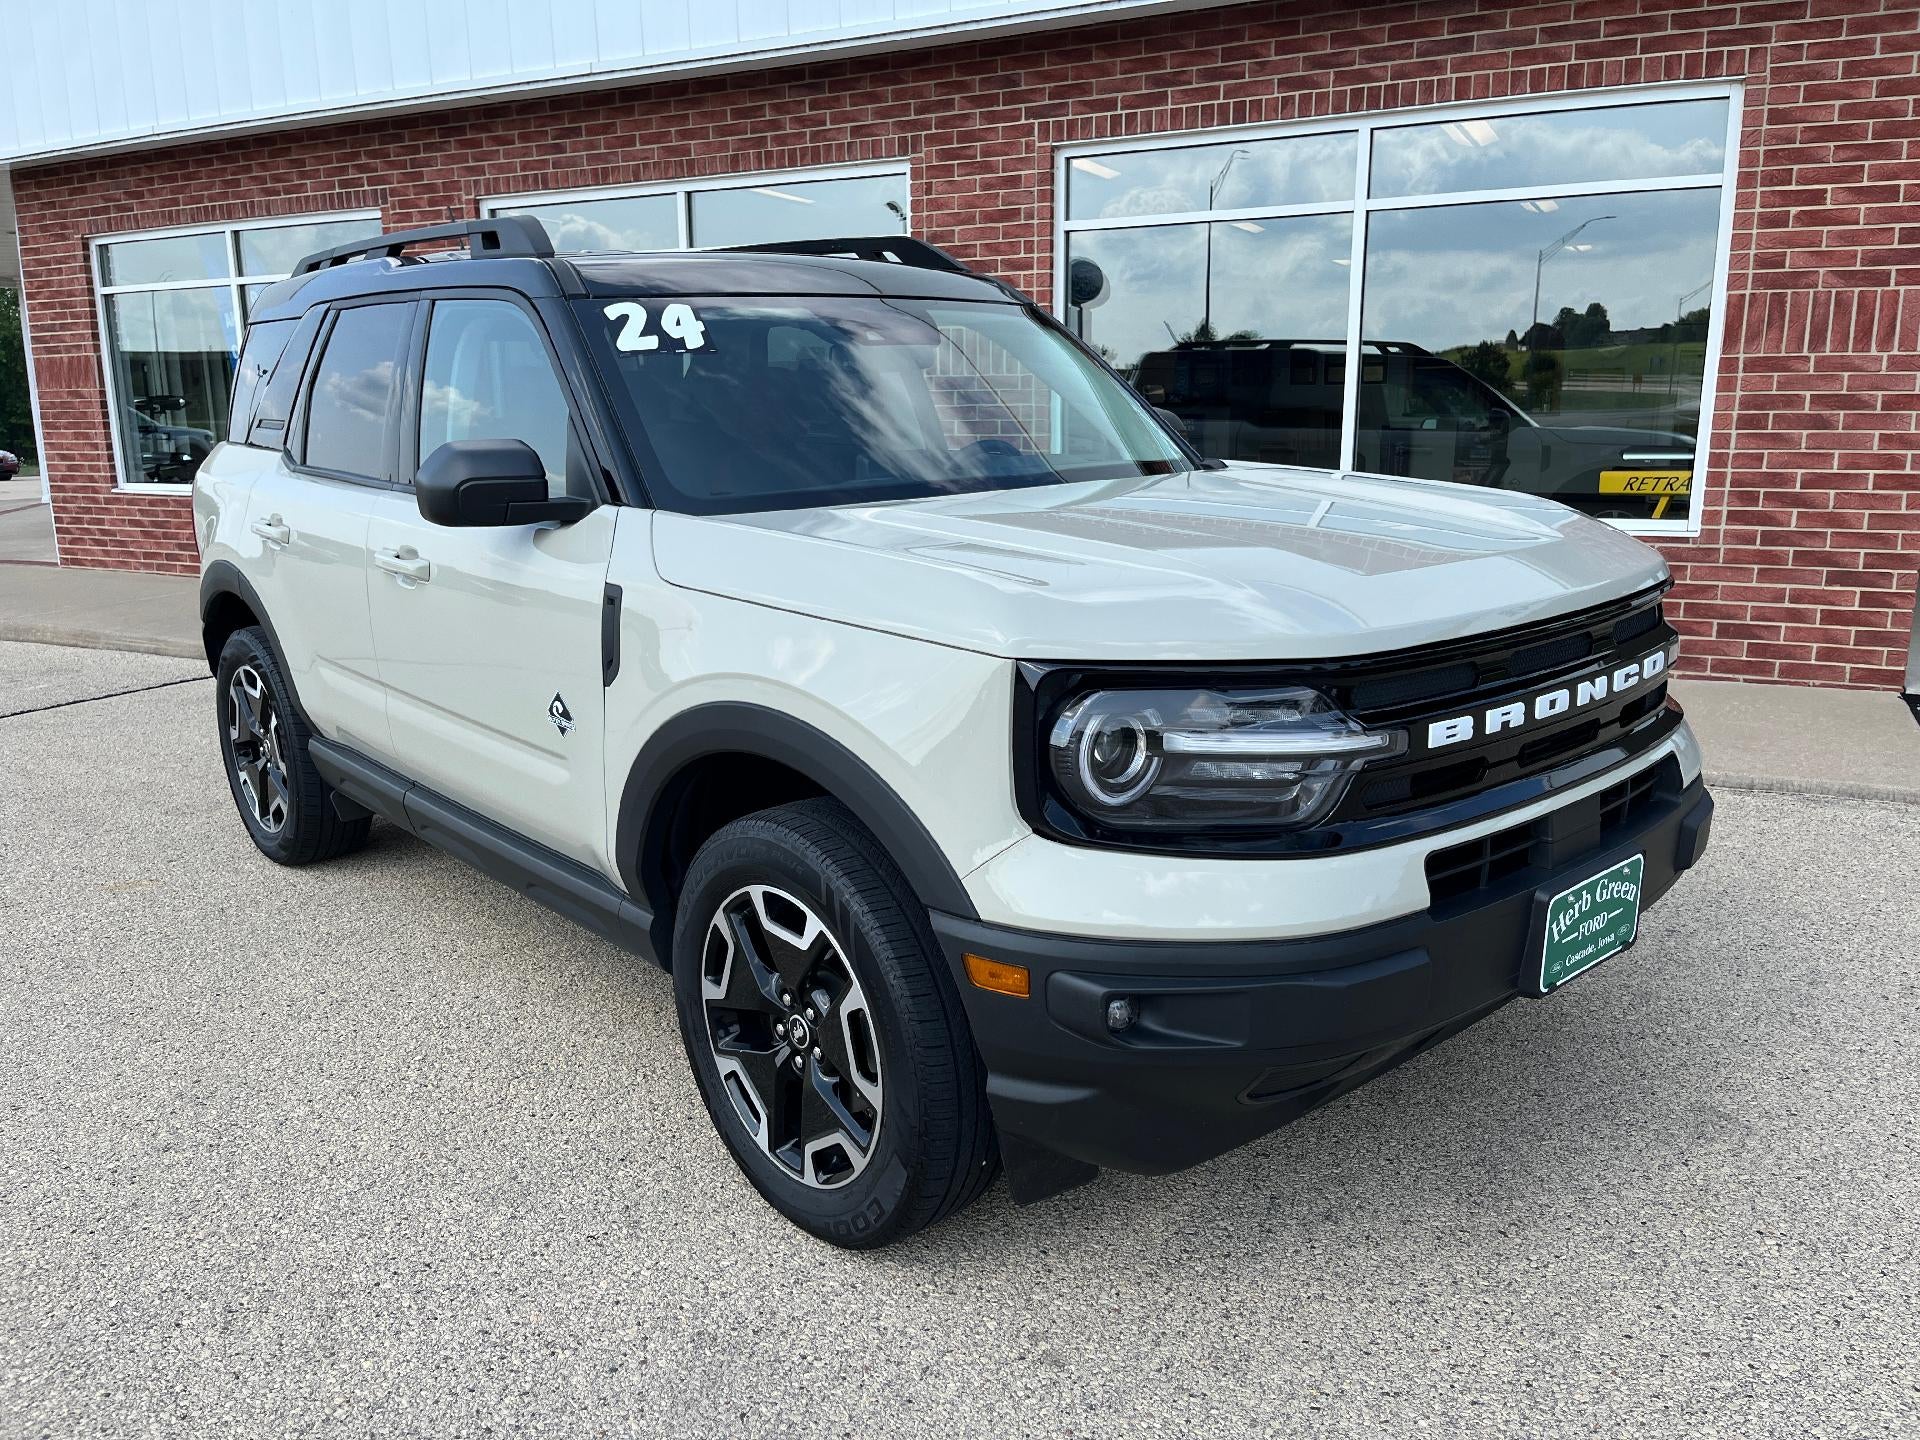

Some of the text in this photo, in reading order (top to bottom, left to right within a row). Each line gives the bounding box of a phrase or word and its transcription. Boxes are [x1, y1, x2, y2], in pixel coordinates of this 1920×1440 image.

[603, 302, 706, 351] 24
[1623, 476, 1691, 492] RETRA
[1428, 650, 1665, 749] BRONCO
[1551, 878, 1637, 944] Herb Green
[1578, 911, 1608, 941] FORD
[1598, 932, 1615, 949] Iowa
